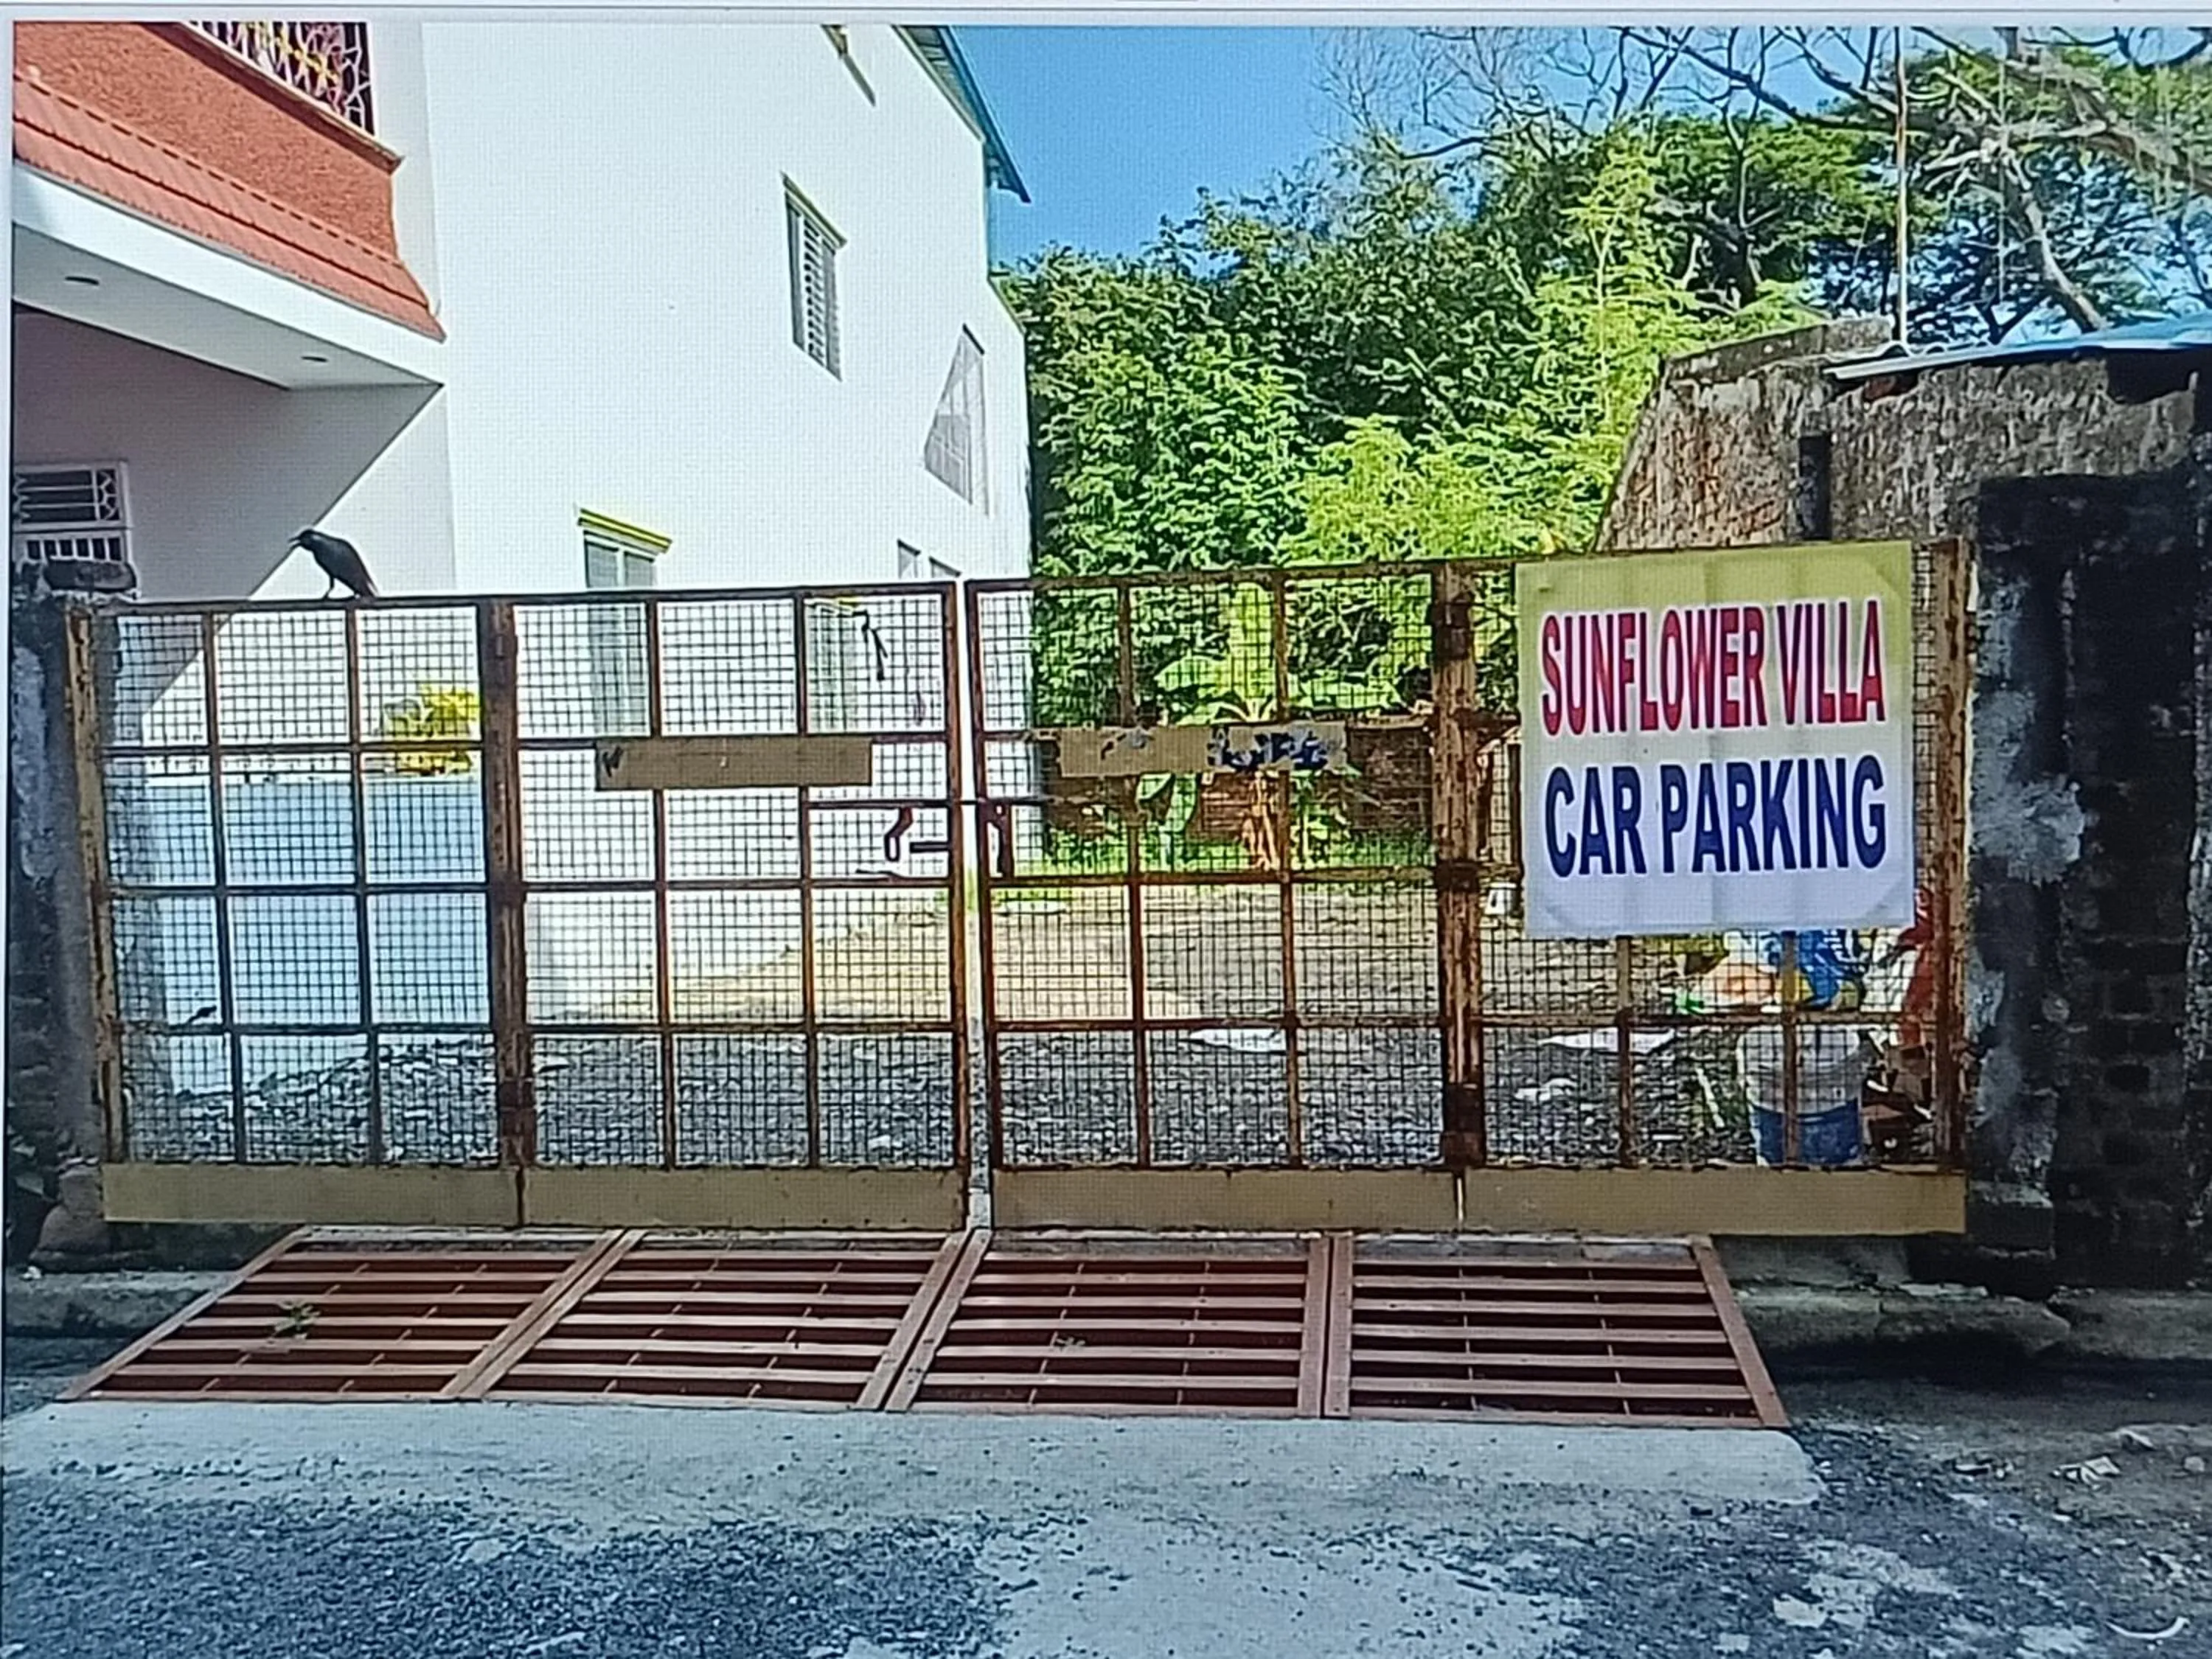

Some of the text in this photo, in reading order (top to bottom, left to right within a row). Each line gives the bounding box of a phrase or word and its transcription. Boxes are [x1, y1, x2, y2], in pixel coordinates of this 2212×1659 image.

[1542, 600, 1885, 736] SUNFLOWER VILLA
[1545, 755, 1886, 877] CAR PARKING
